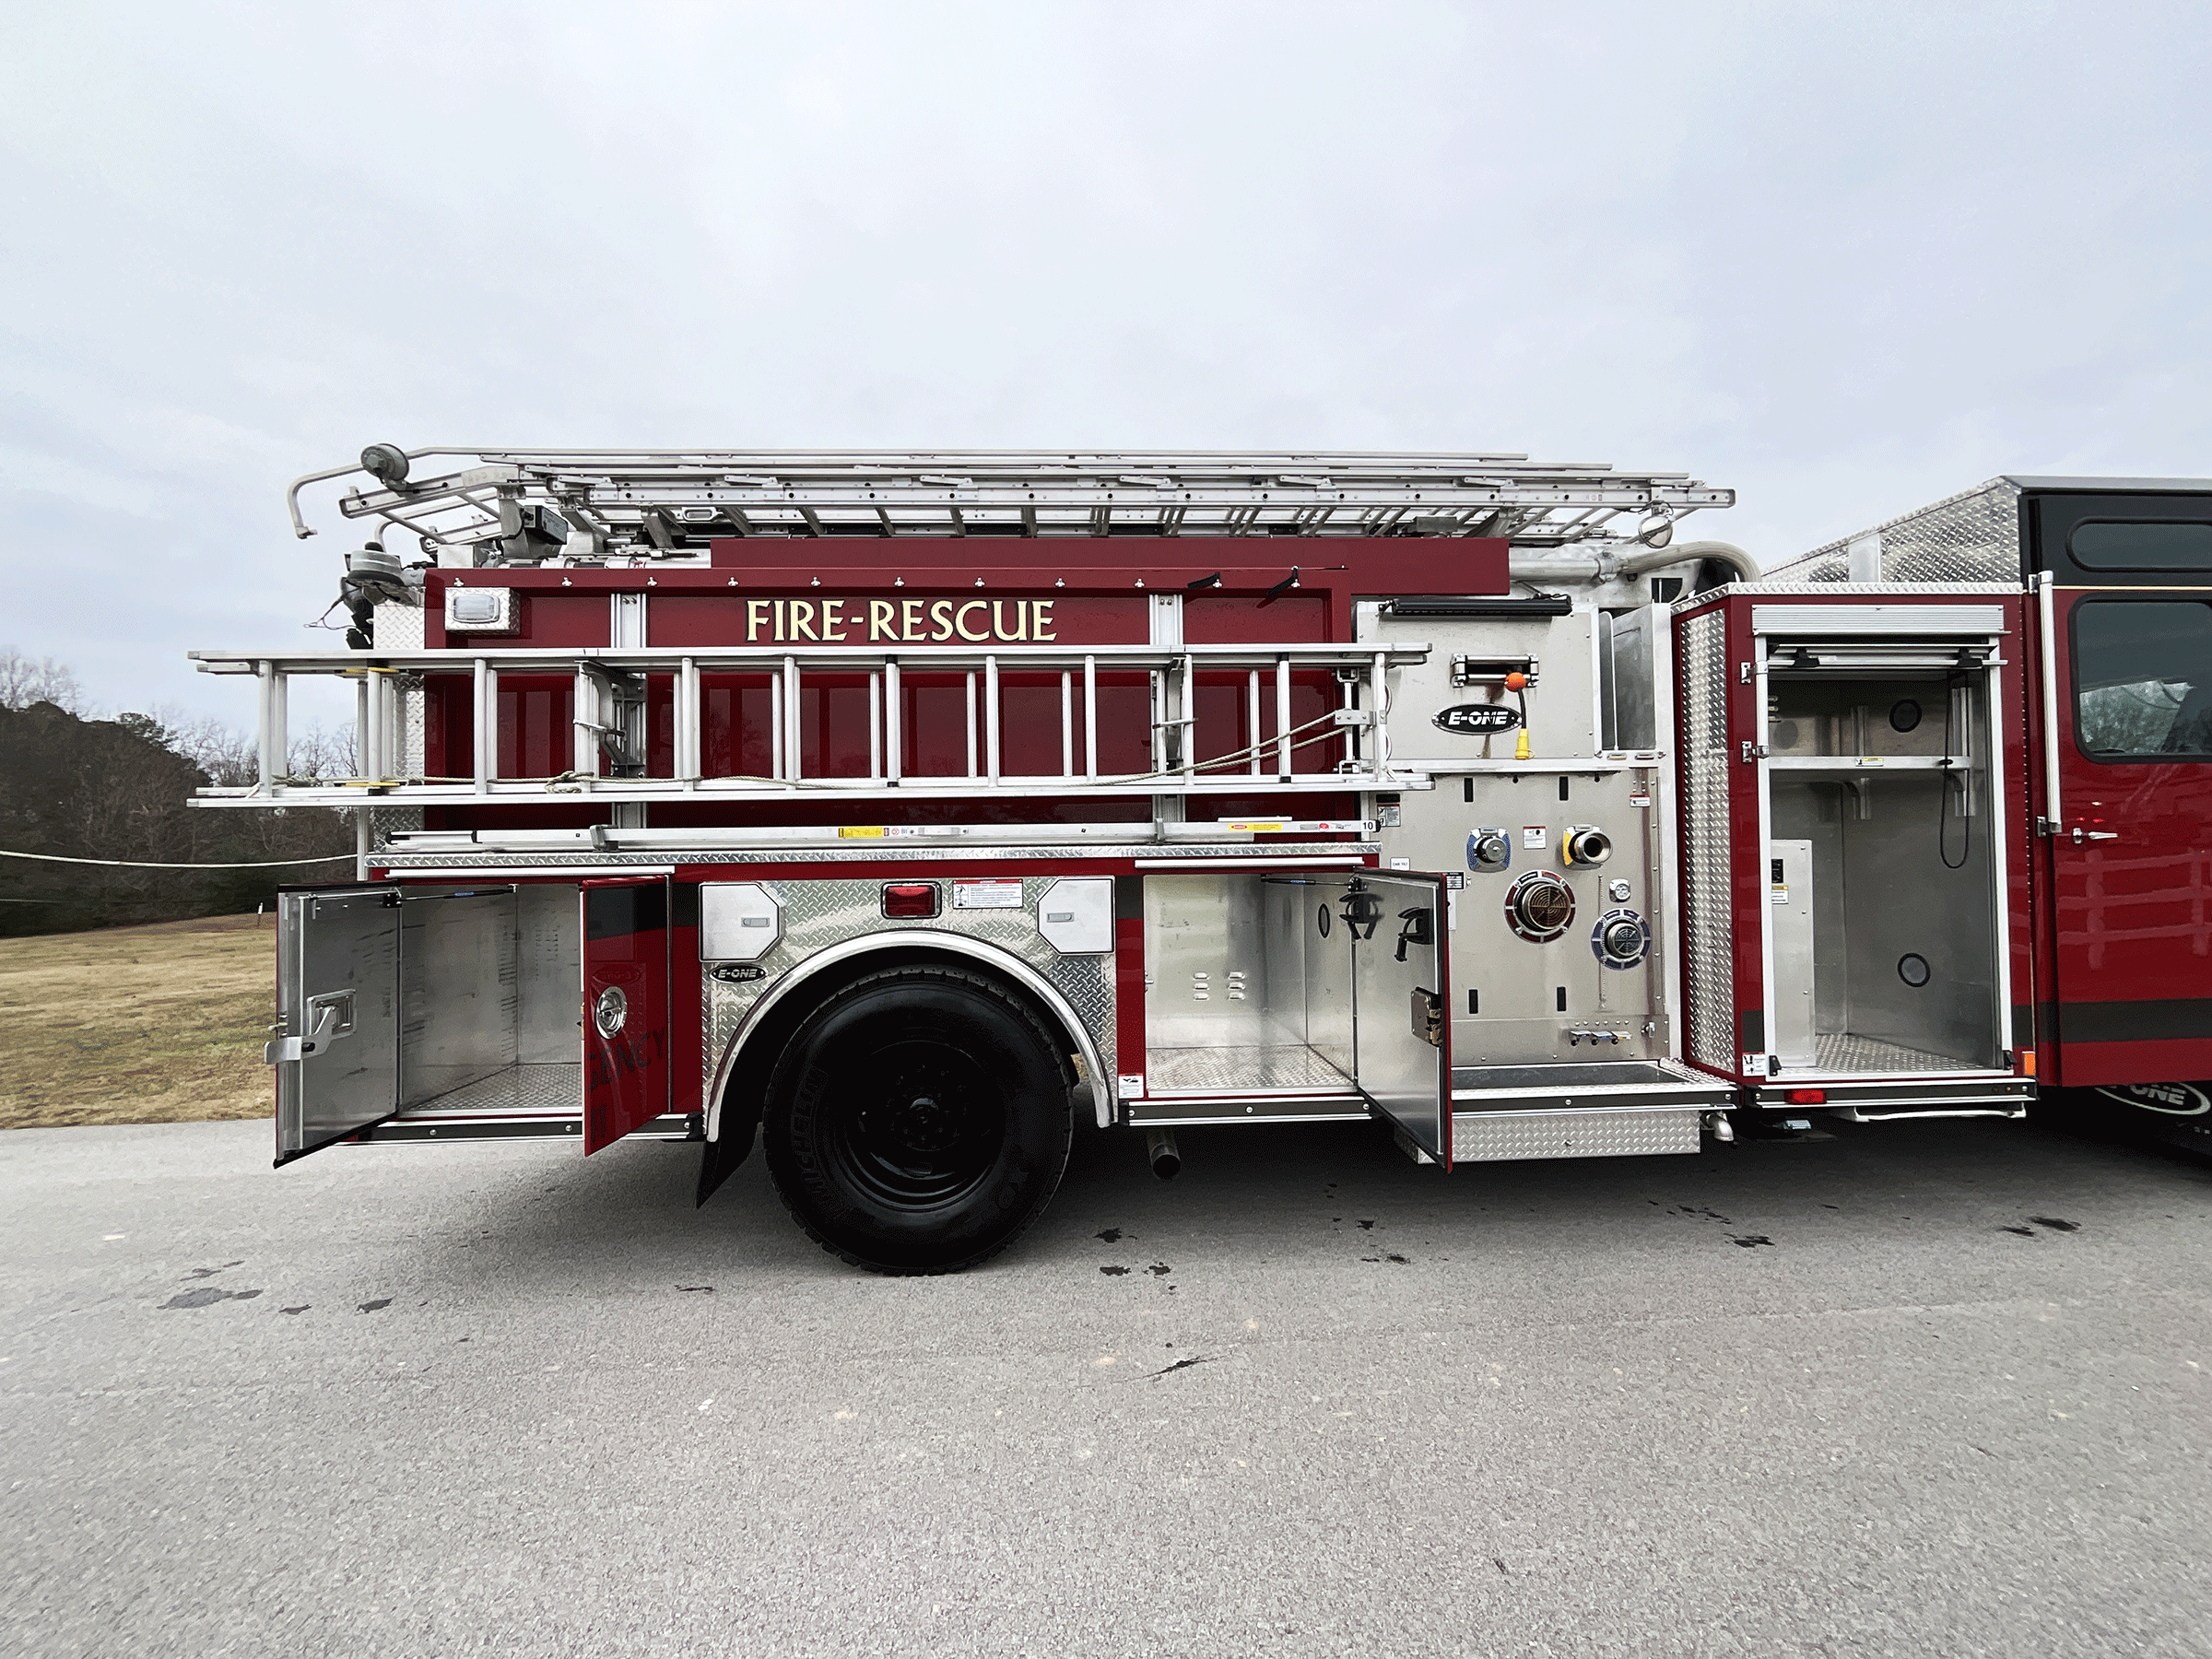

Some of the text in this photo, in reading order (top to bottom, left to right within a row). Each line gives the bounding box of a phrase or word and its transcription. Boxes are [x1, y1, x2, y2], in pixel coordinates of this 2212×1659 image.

[747, 599, 1057, 641] FIRE-RESCUE
[1448, 711, 1509, 725] E-ONE
[1363, 821, 1373, 830] 10
[718, 969, 758, 978] E-ONE
